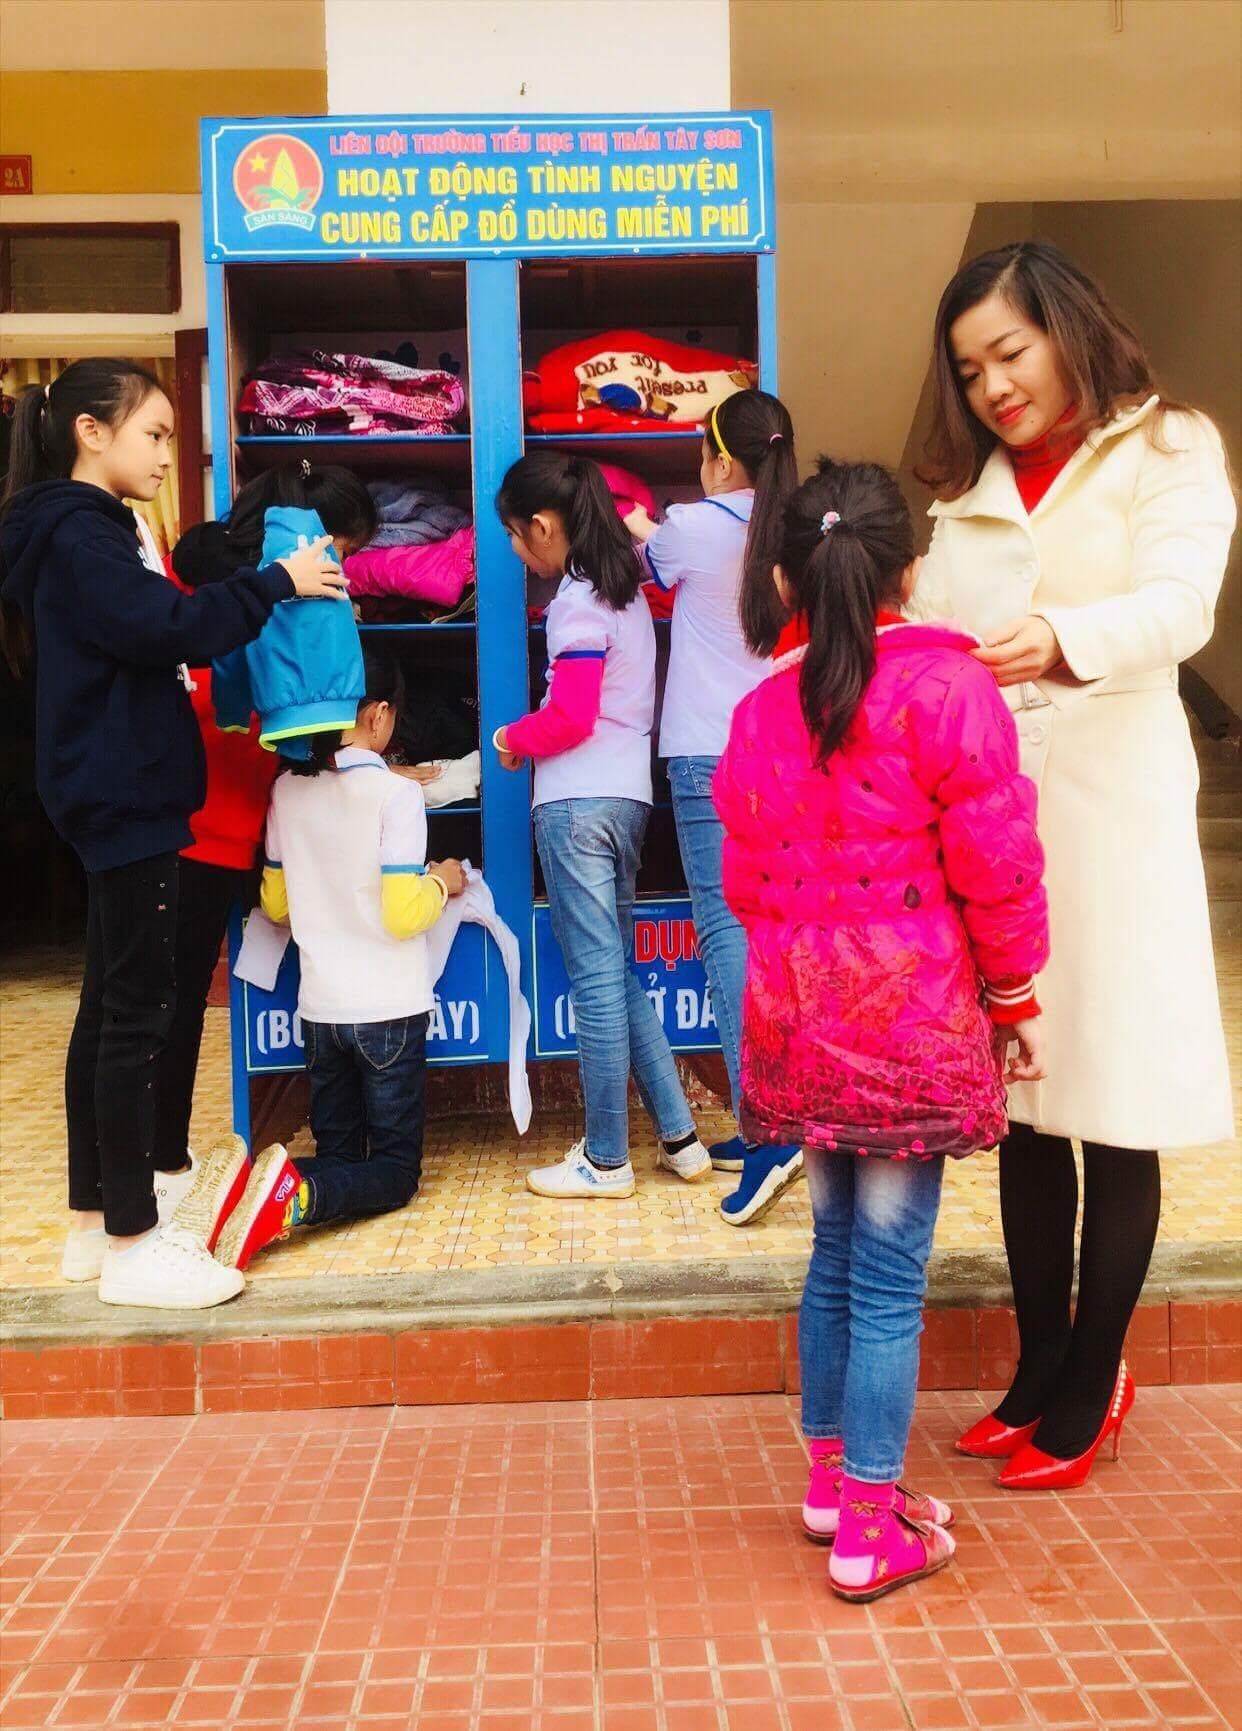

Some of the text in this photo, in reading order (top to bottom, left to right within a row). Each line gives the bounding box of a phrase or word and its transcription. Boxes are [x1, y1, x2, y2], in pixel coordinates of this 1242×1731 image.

[330, 131, 372, 155] LIÊN
[375, 130, 408, 158] ĐỘI
[413, 128, 487, 154] TRƯỜNG
[536, 132, 574, 156] HỌC
[579, 132, 608, 155] THỊ
[612, 125, 661, 151] TRẤN
[664, 127, 699, 150] TÂY
[704, 128, 742, 150] SƠN
[337, 157, 738, 202] HOẠT ĐỘNG TÌNH NGUYỆN
[320, 194, 749, 244] CUNG CẤP ĐỒ DÙNG MIỄN PHÍ
[635, 920, 702, 971] DỤN
